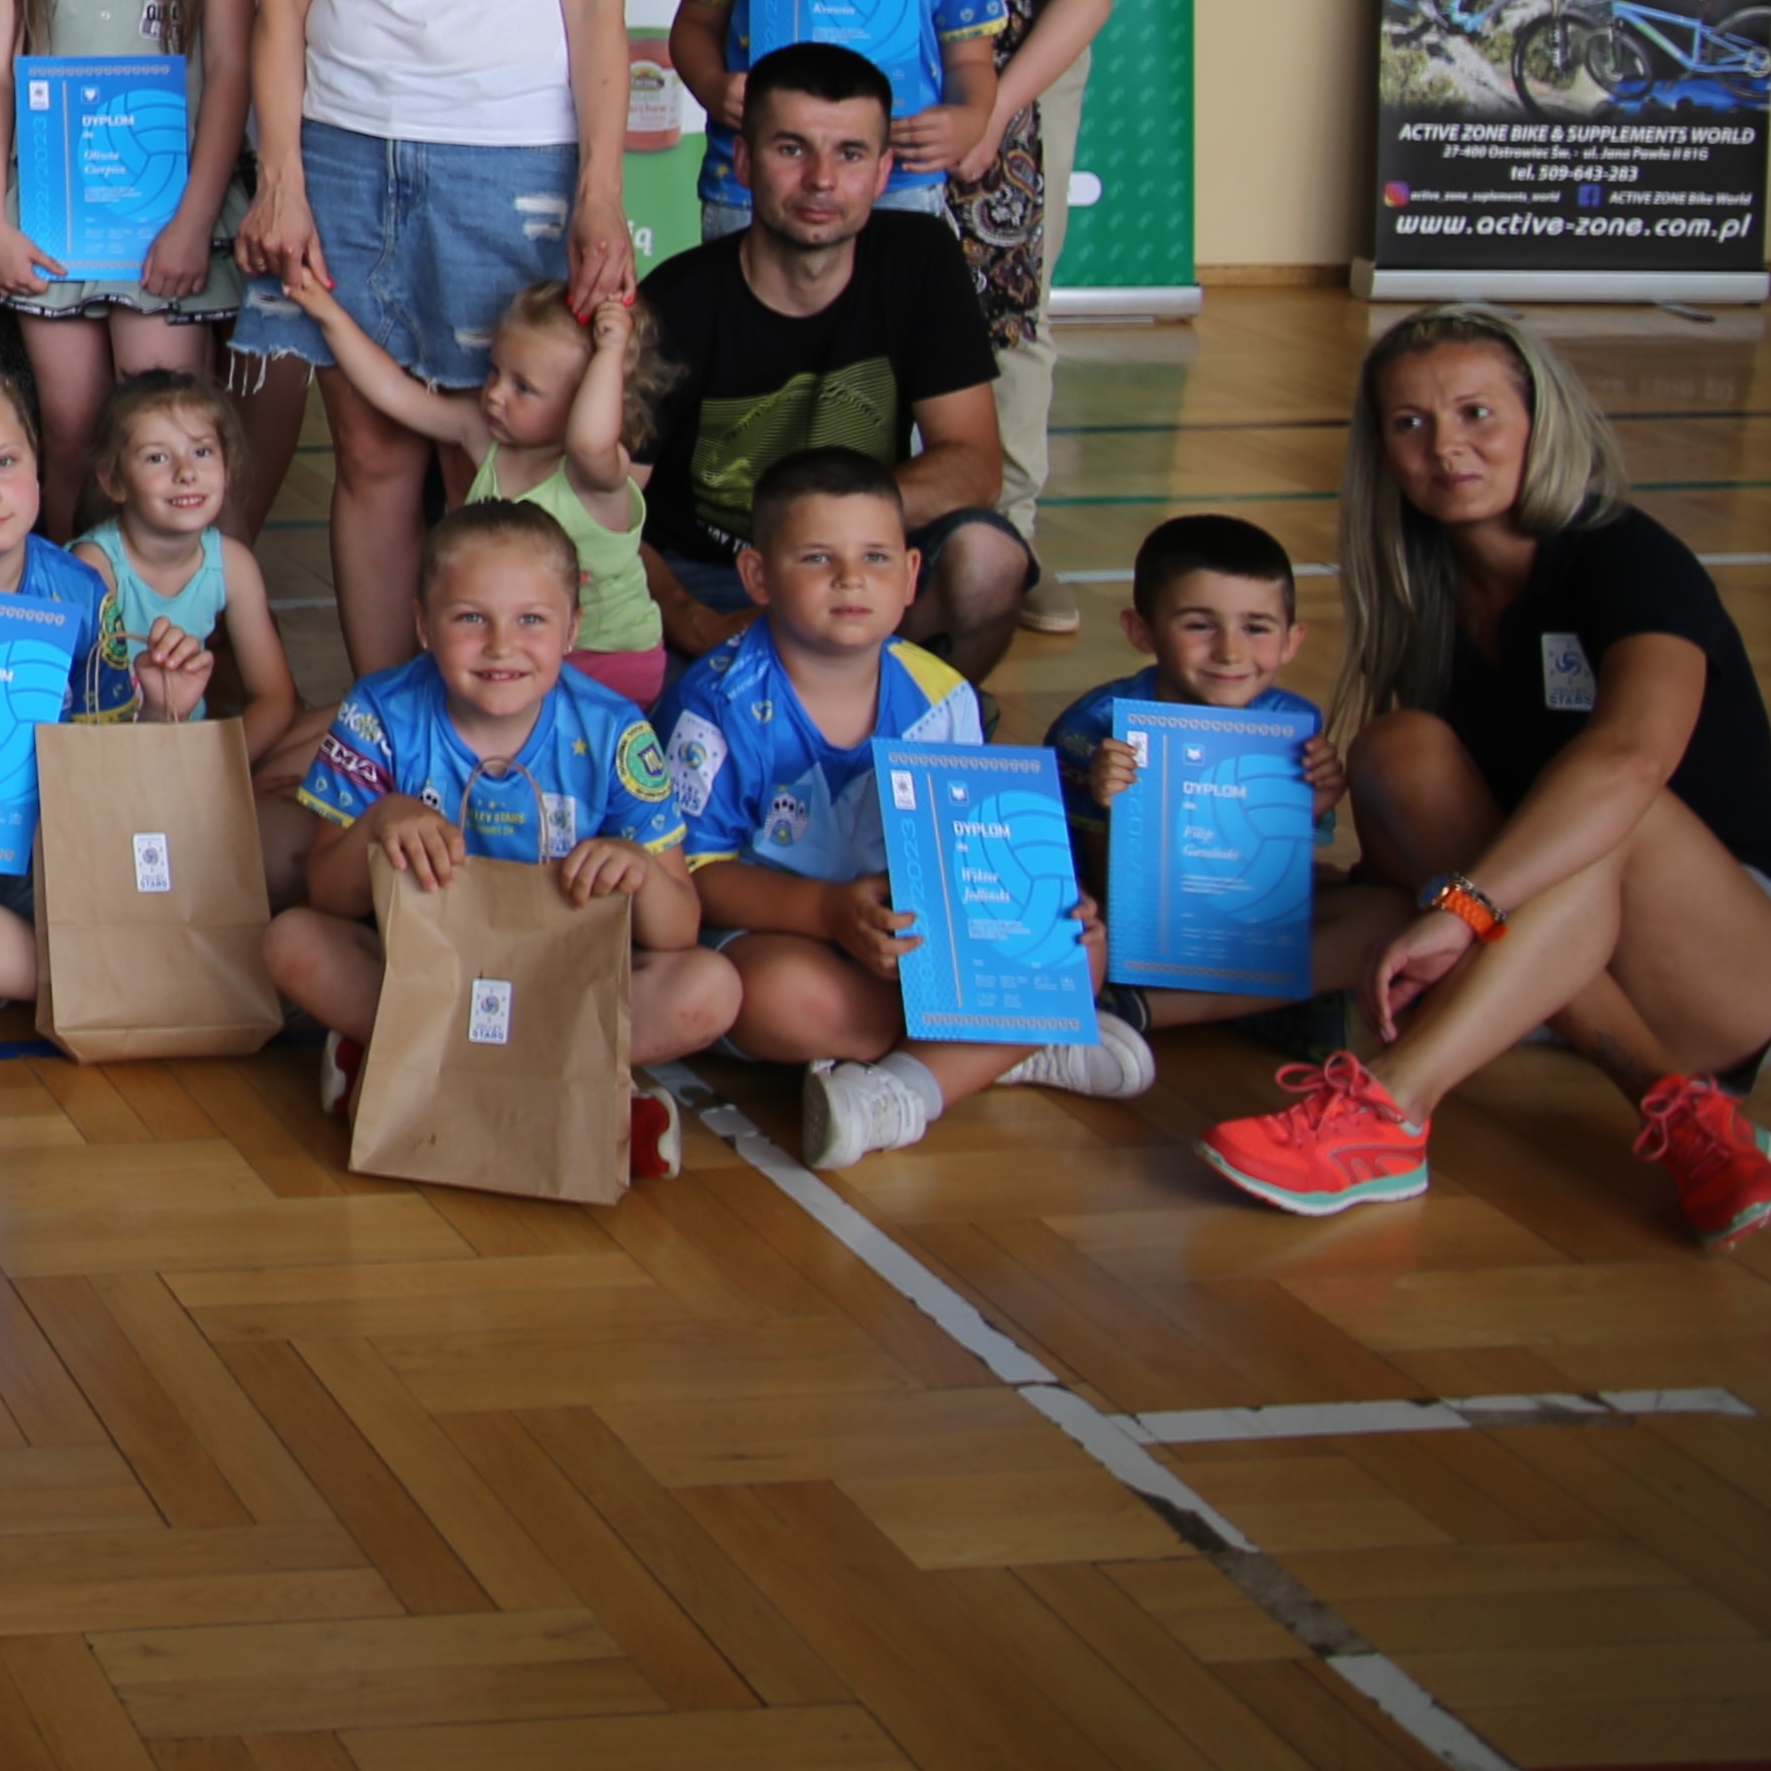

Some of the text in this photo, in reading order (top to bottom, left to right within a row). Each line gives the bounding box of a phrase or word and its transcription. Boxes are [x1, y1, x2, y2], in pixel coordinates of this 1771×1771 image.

[81, 114, 135, 127] DYPLOM
[1398, 123, 1755, 145] ACTIVE ZONE BIKE & SUPPLEMENTS WORLD
[1395, 212, 1753, 244] www.active-zone.com.pl
[1184, 780, 1247, 799] DYPLOM
[953, 820, 1011, 839] DYPLOM
